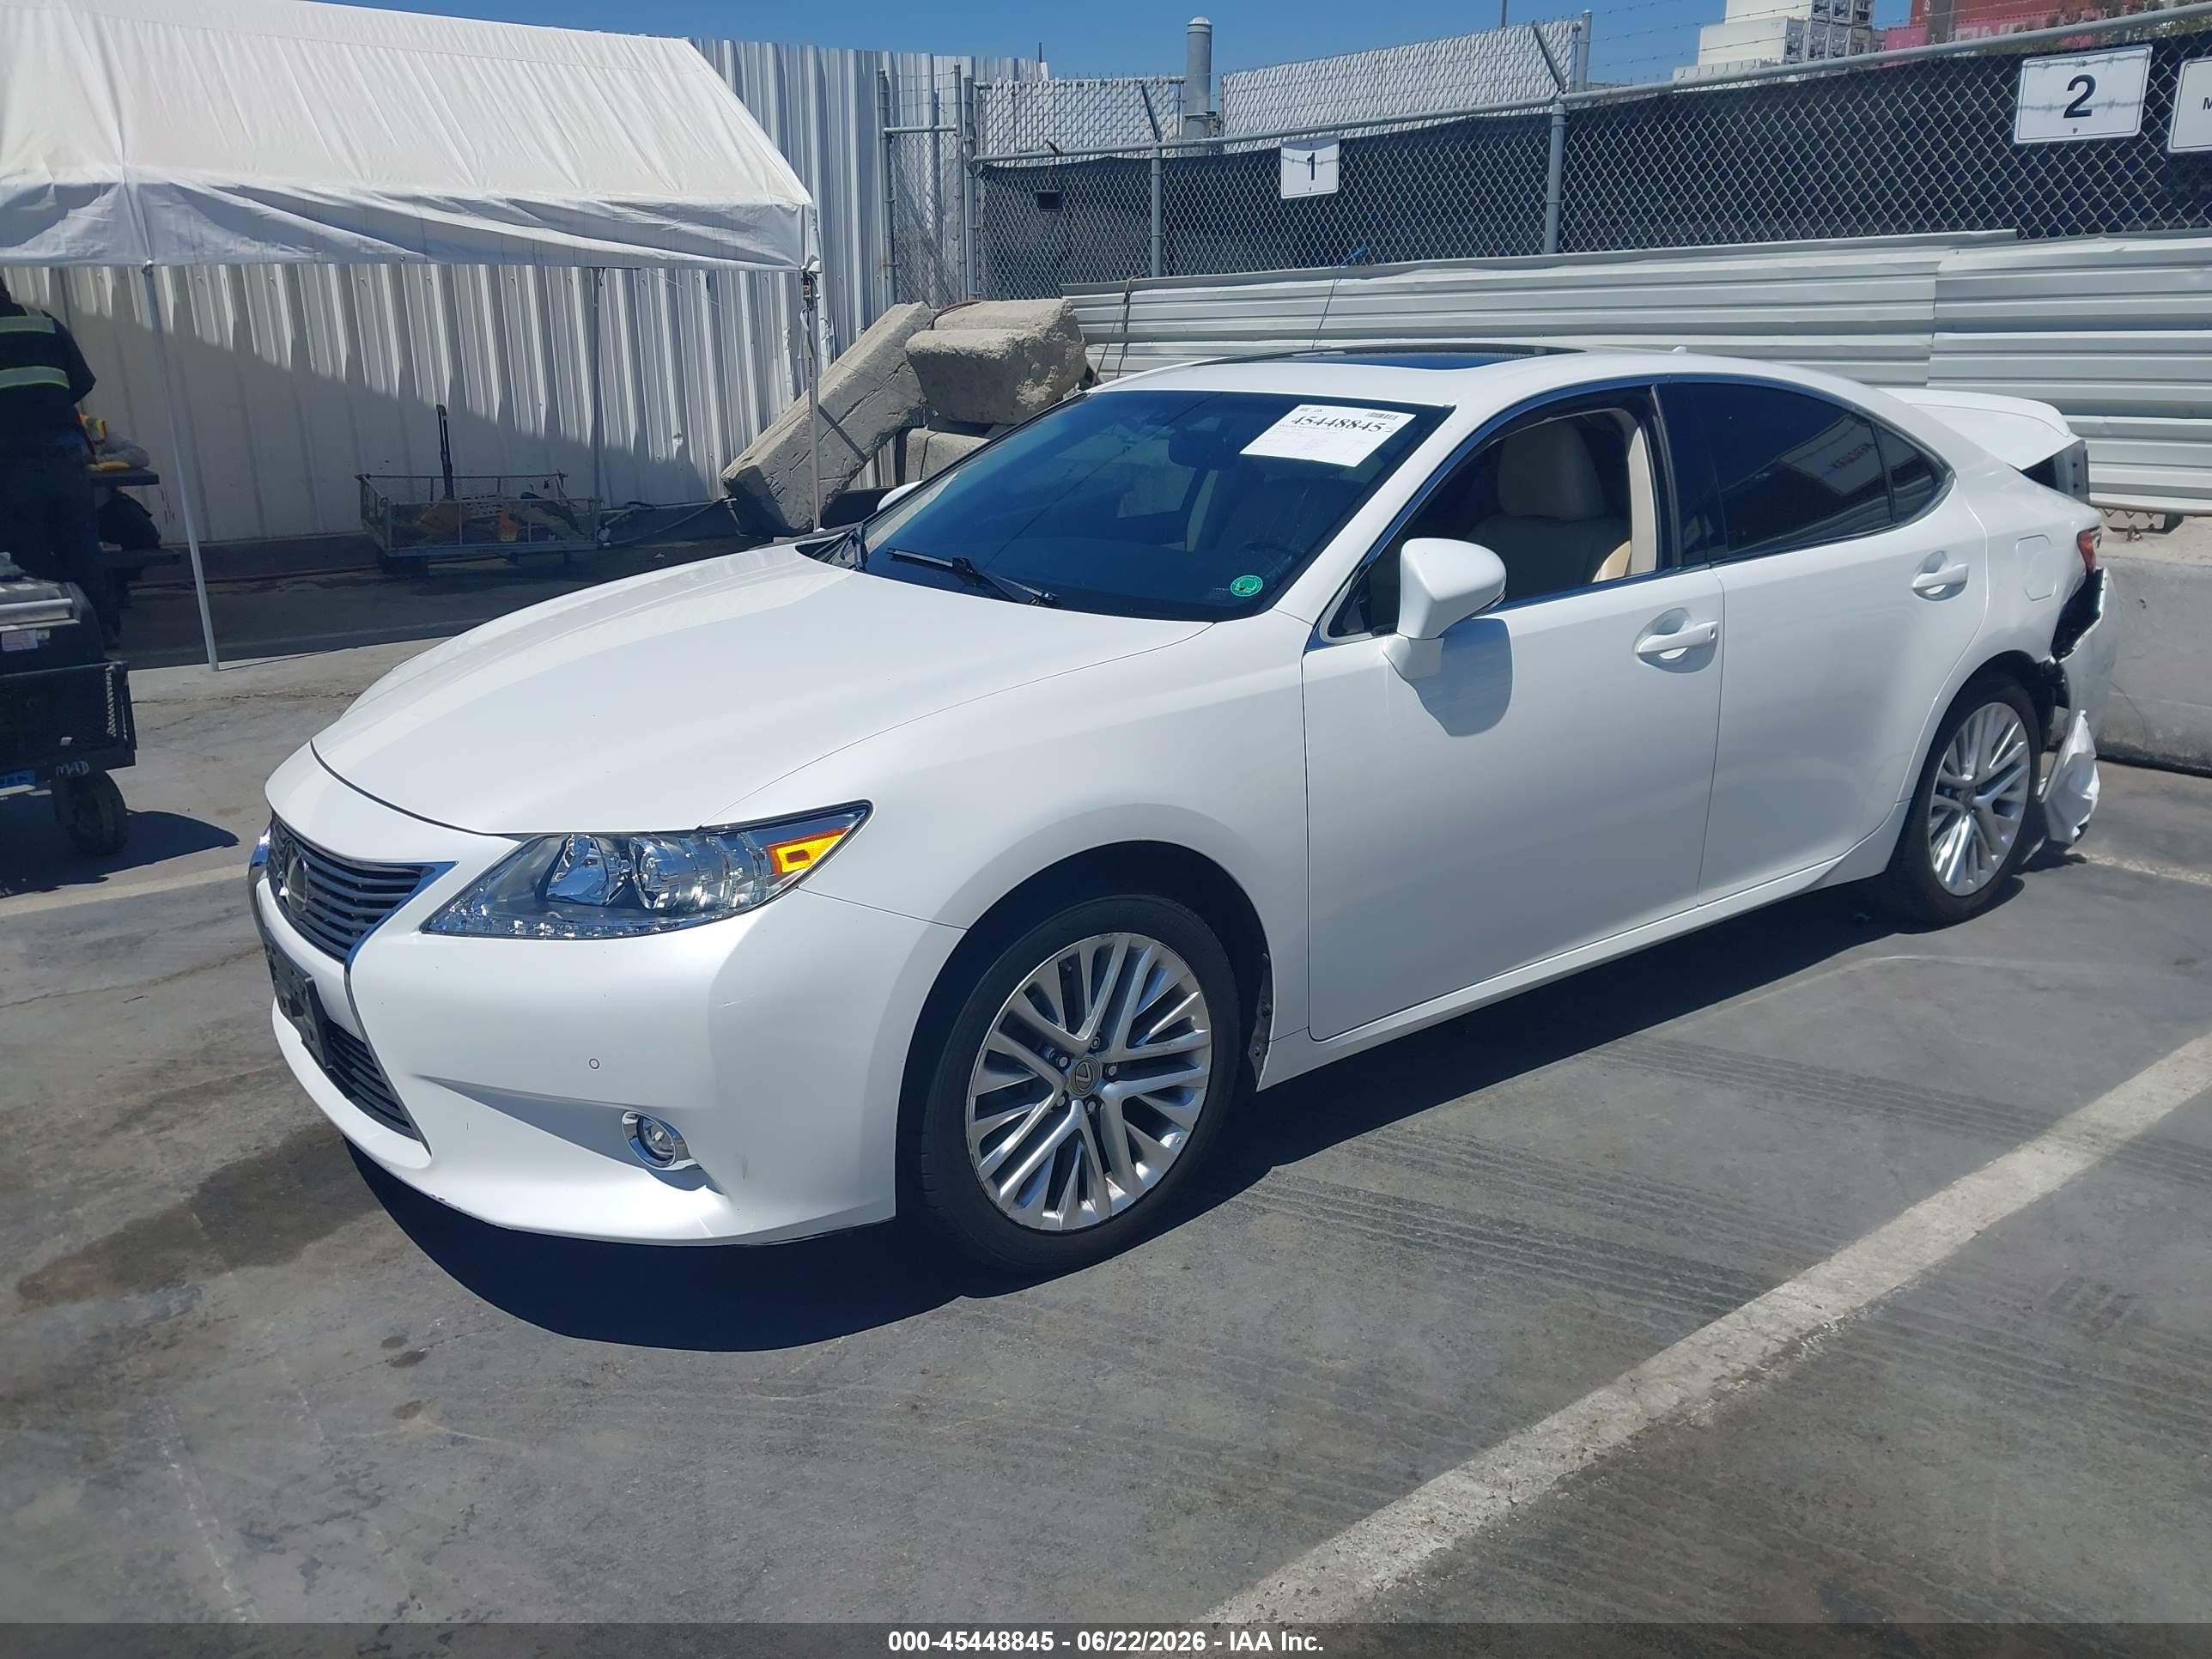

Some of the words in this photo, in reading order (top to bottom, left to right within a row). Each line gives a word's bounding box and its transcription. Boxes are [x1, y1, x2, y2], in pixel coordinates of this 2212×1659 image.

[2063, 74, 2096, 118] 2
[1307, 152, 1316, 181] 1
[1291, 416, 1387, 432] 45448845
